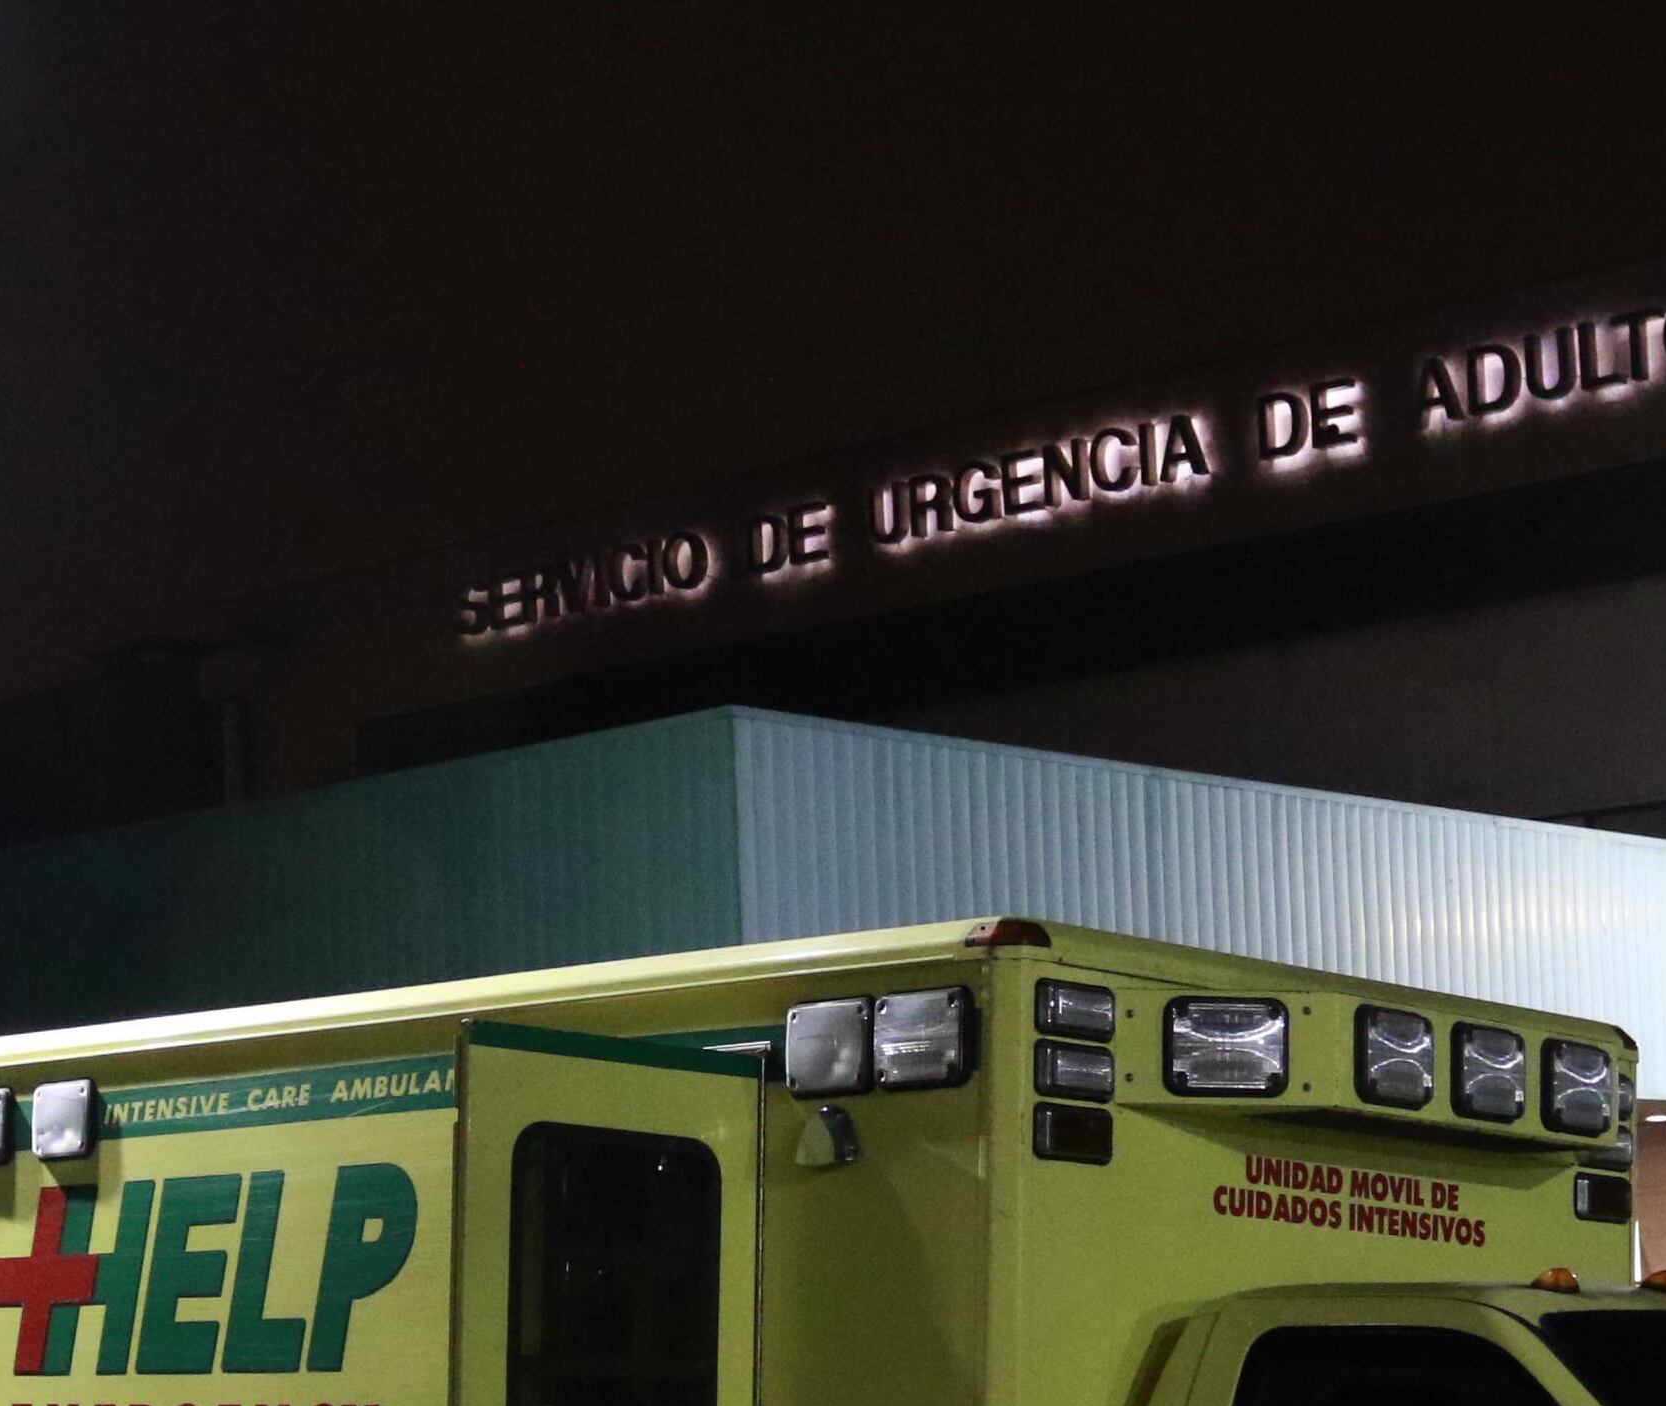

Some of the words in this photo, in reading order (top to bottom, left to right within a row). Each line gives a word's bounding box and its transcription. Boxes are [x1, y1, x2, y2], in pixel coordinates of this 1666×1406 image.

[457, 531, 709, 637] SERVICIO
[746, 500, 831, 575] DE
[866, 413, 1211, 546] URGENCIA
[1257, 376, 1358, 461] DE
[104, 1089, 230, 1126] INTENSIVE
[246, 1082, 312, 1112] CARE
[1245, 1155, 1343, 1194] UNIDAD
[1350, 1170, 1424, 1206] MOVIL
[1431, 1182, 1460, 1211] DE
[1213, 1185, 1342, 1229] CUIDADOS
[1349, 1206, 1485, 1247] INTENSIVOS
[37, 1160, 419, 1376] HELP
